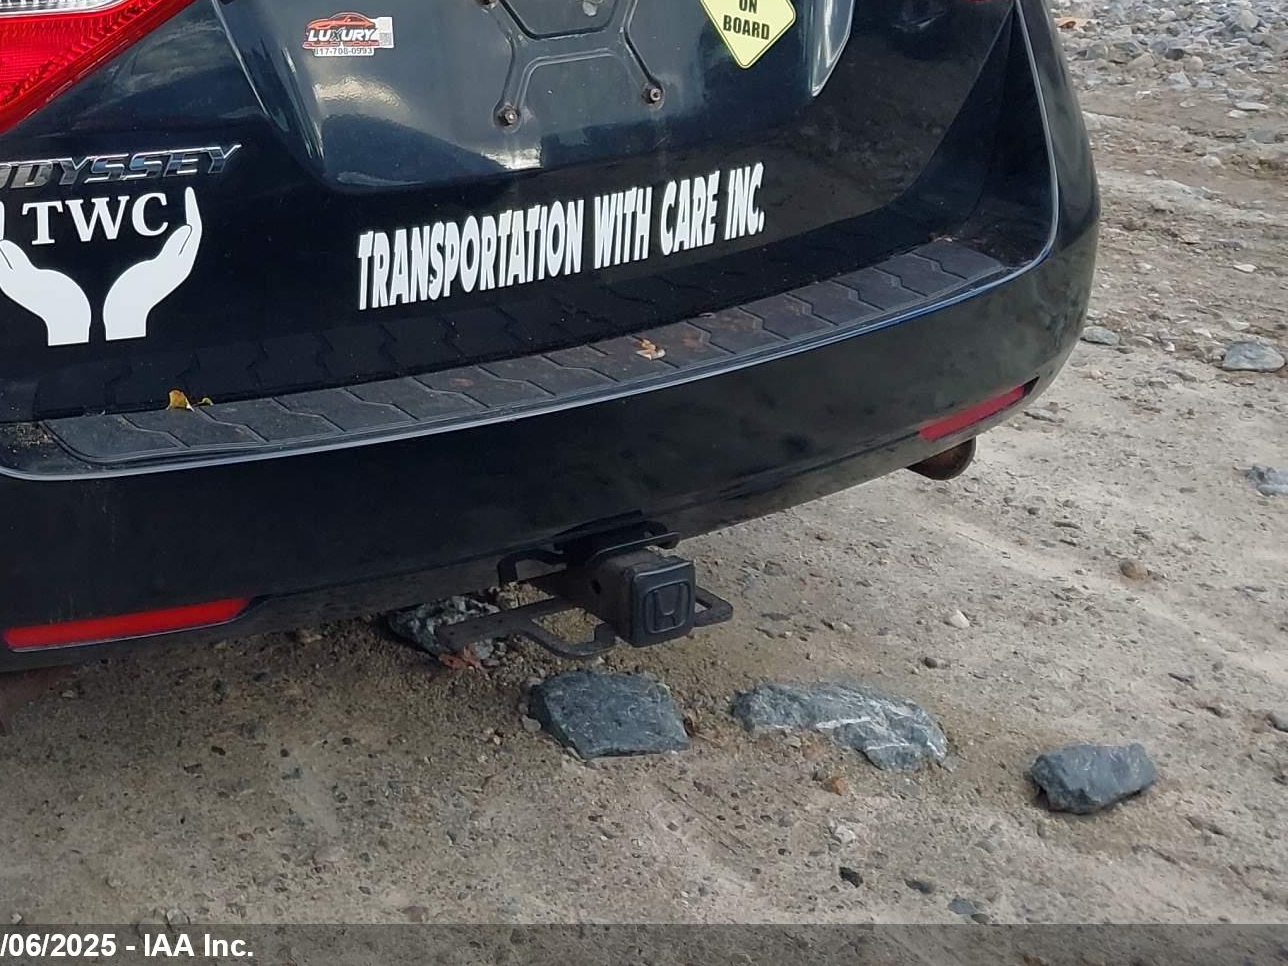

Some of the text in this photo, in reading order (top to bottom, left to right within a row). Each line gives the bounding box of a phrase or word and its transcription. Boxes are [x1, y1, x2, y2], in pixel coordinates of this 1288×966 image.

[308, 26, 376, 42] LUXURY
[723, 14, 770, 41] BOARD
[21, 192, 169, 245] TWC
[358, 162, 765, 310] TRANSPORTATION WITH CARE INC.
